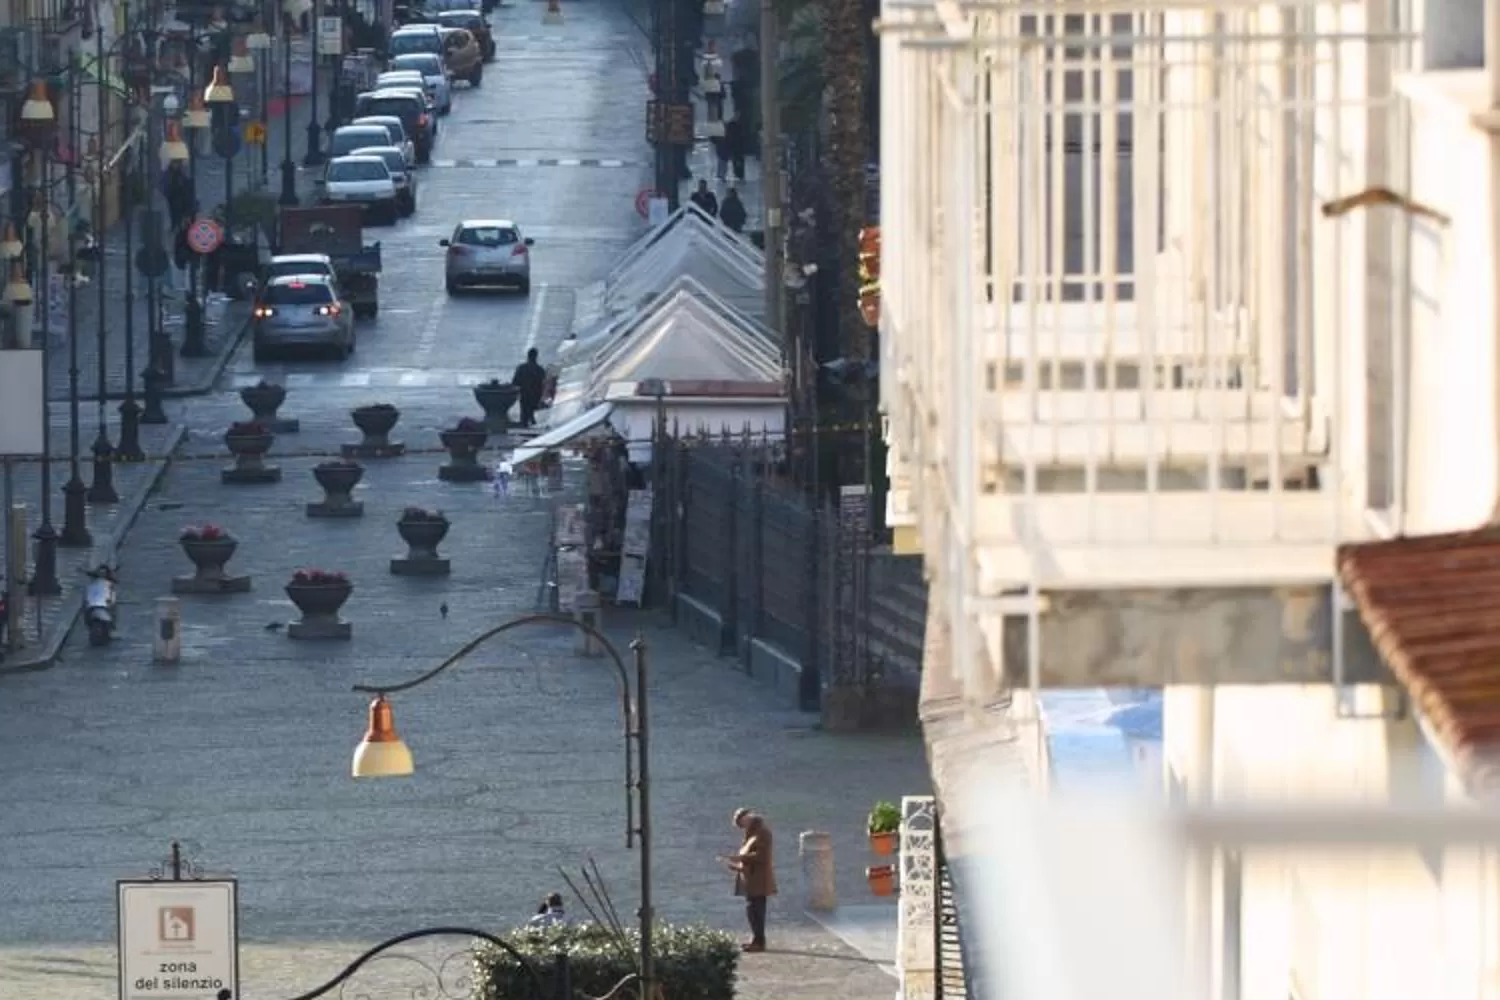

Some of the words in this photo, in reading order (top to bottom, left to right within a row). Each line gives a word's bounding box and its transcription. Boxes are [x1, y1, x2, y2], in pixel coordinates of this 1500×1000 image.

[159, 962, 197, 973] zona
[134, 977, 159, 990] del
[163, 976, 223, 990] silenzio
